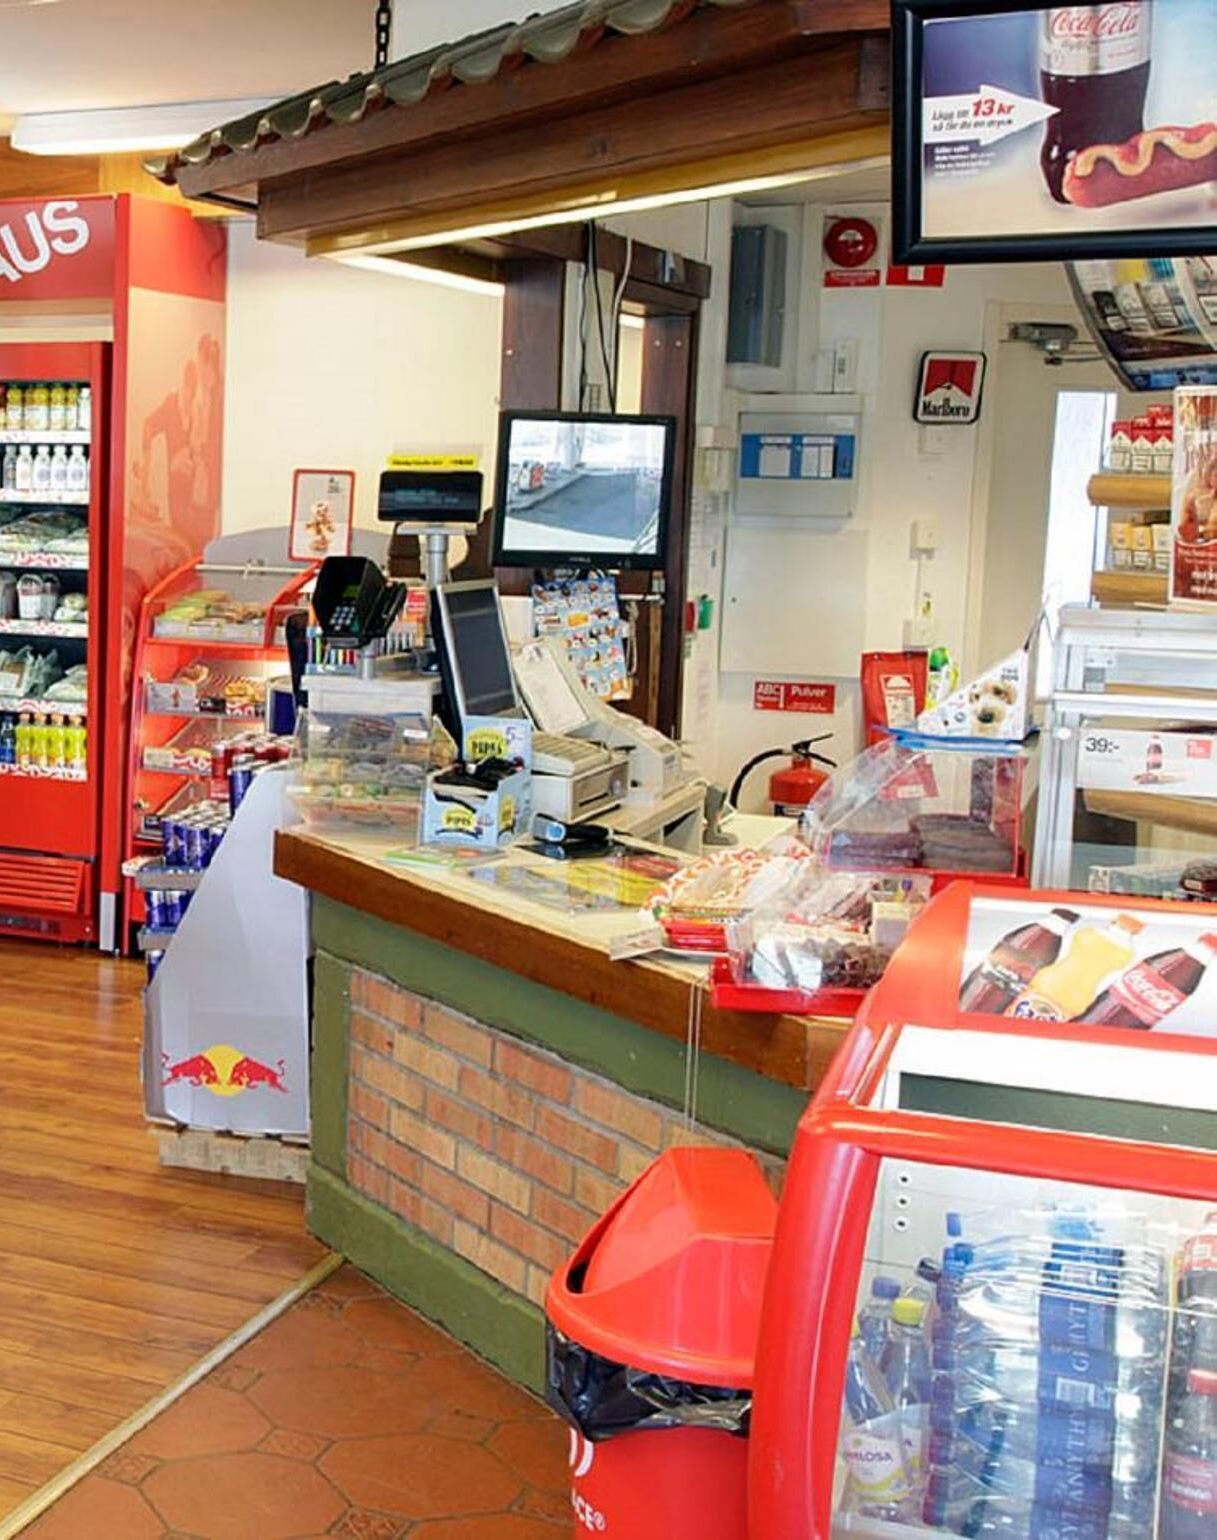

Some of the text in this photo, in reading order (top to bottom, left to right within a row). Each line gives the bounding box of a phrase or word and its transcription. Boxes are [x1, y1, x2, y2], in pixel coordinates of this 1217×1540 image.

[973, 98, 996, 117] 13
[997, 103, 1015, 115] kr
[921, 397, 970, 417] Marlboro
[1085, 736, 1120, 754] 39:-
